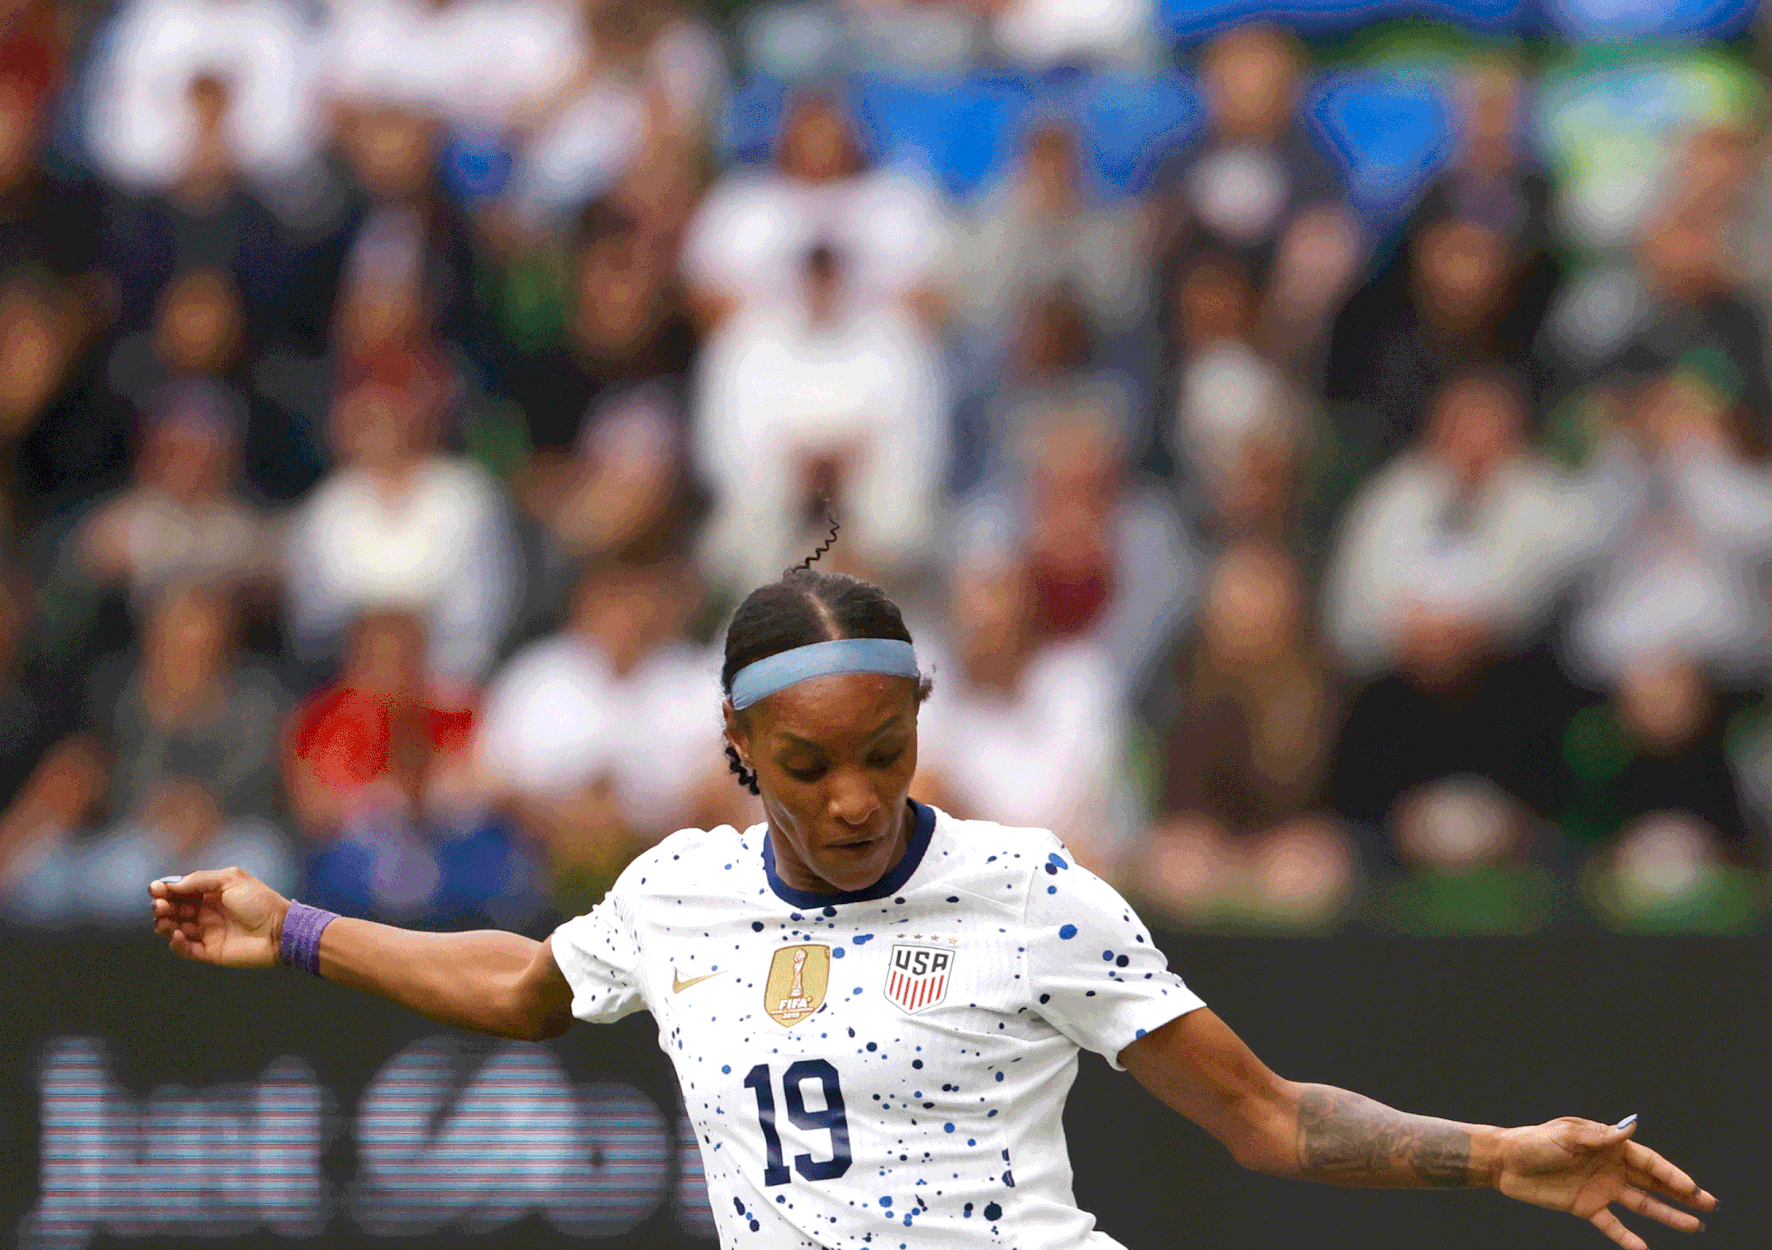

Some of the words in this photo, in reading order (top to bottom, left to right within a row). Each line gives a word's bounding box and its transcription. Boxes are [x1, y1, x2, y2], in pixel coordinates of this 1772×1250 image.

[895, 949, 949, 976] USA
[779, 998, 808, 1010] FIFA
[744, 1059, 853, 1187] 19
